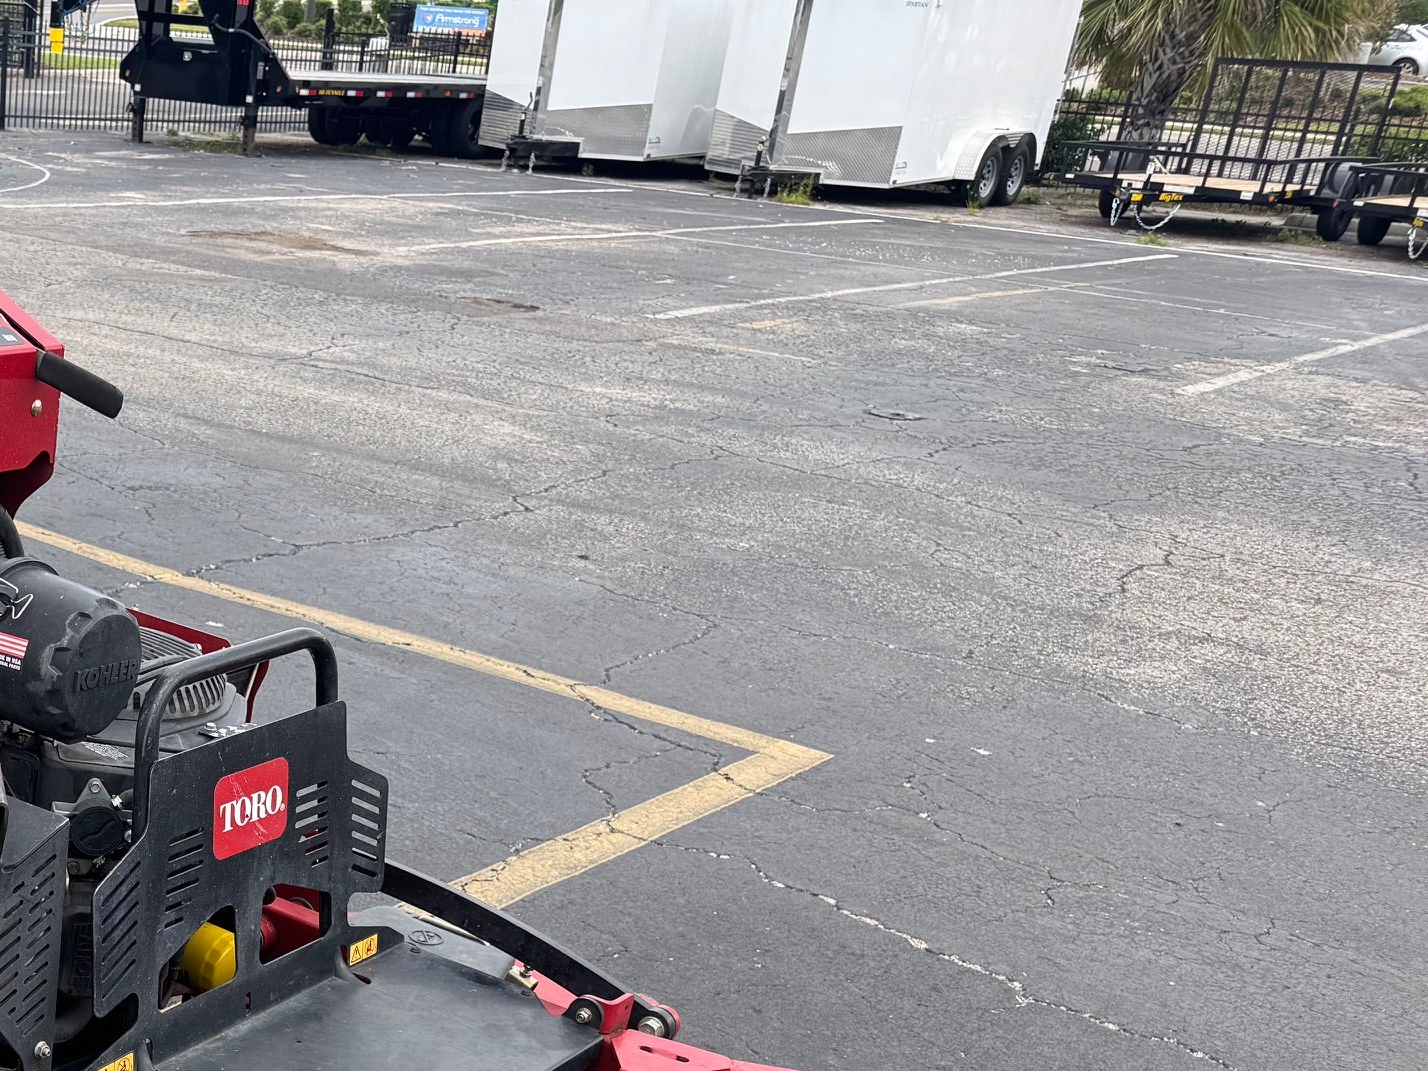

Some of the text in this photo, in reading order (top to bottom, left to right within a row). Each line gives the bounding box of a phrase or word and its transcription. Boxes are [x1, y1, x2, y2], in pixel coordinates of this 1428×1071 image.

[435, 13, 479, 28] Armstrong
[73, 659, 138, 692] KOHLER
[219, 785, 284, 833] TORO
